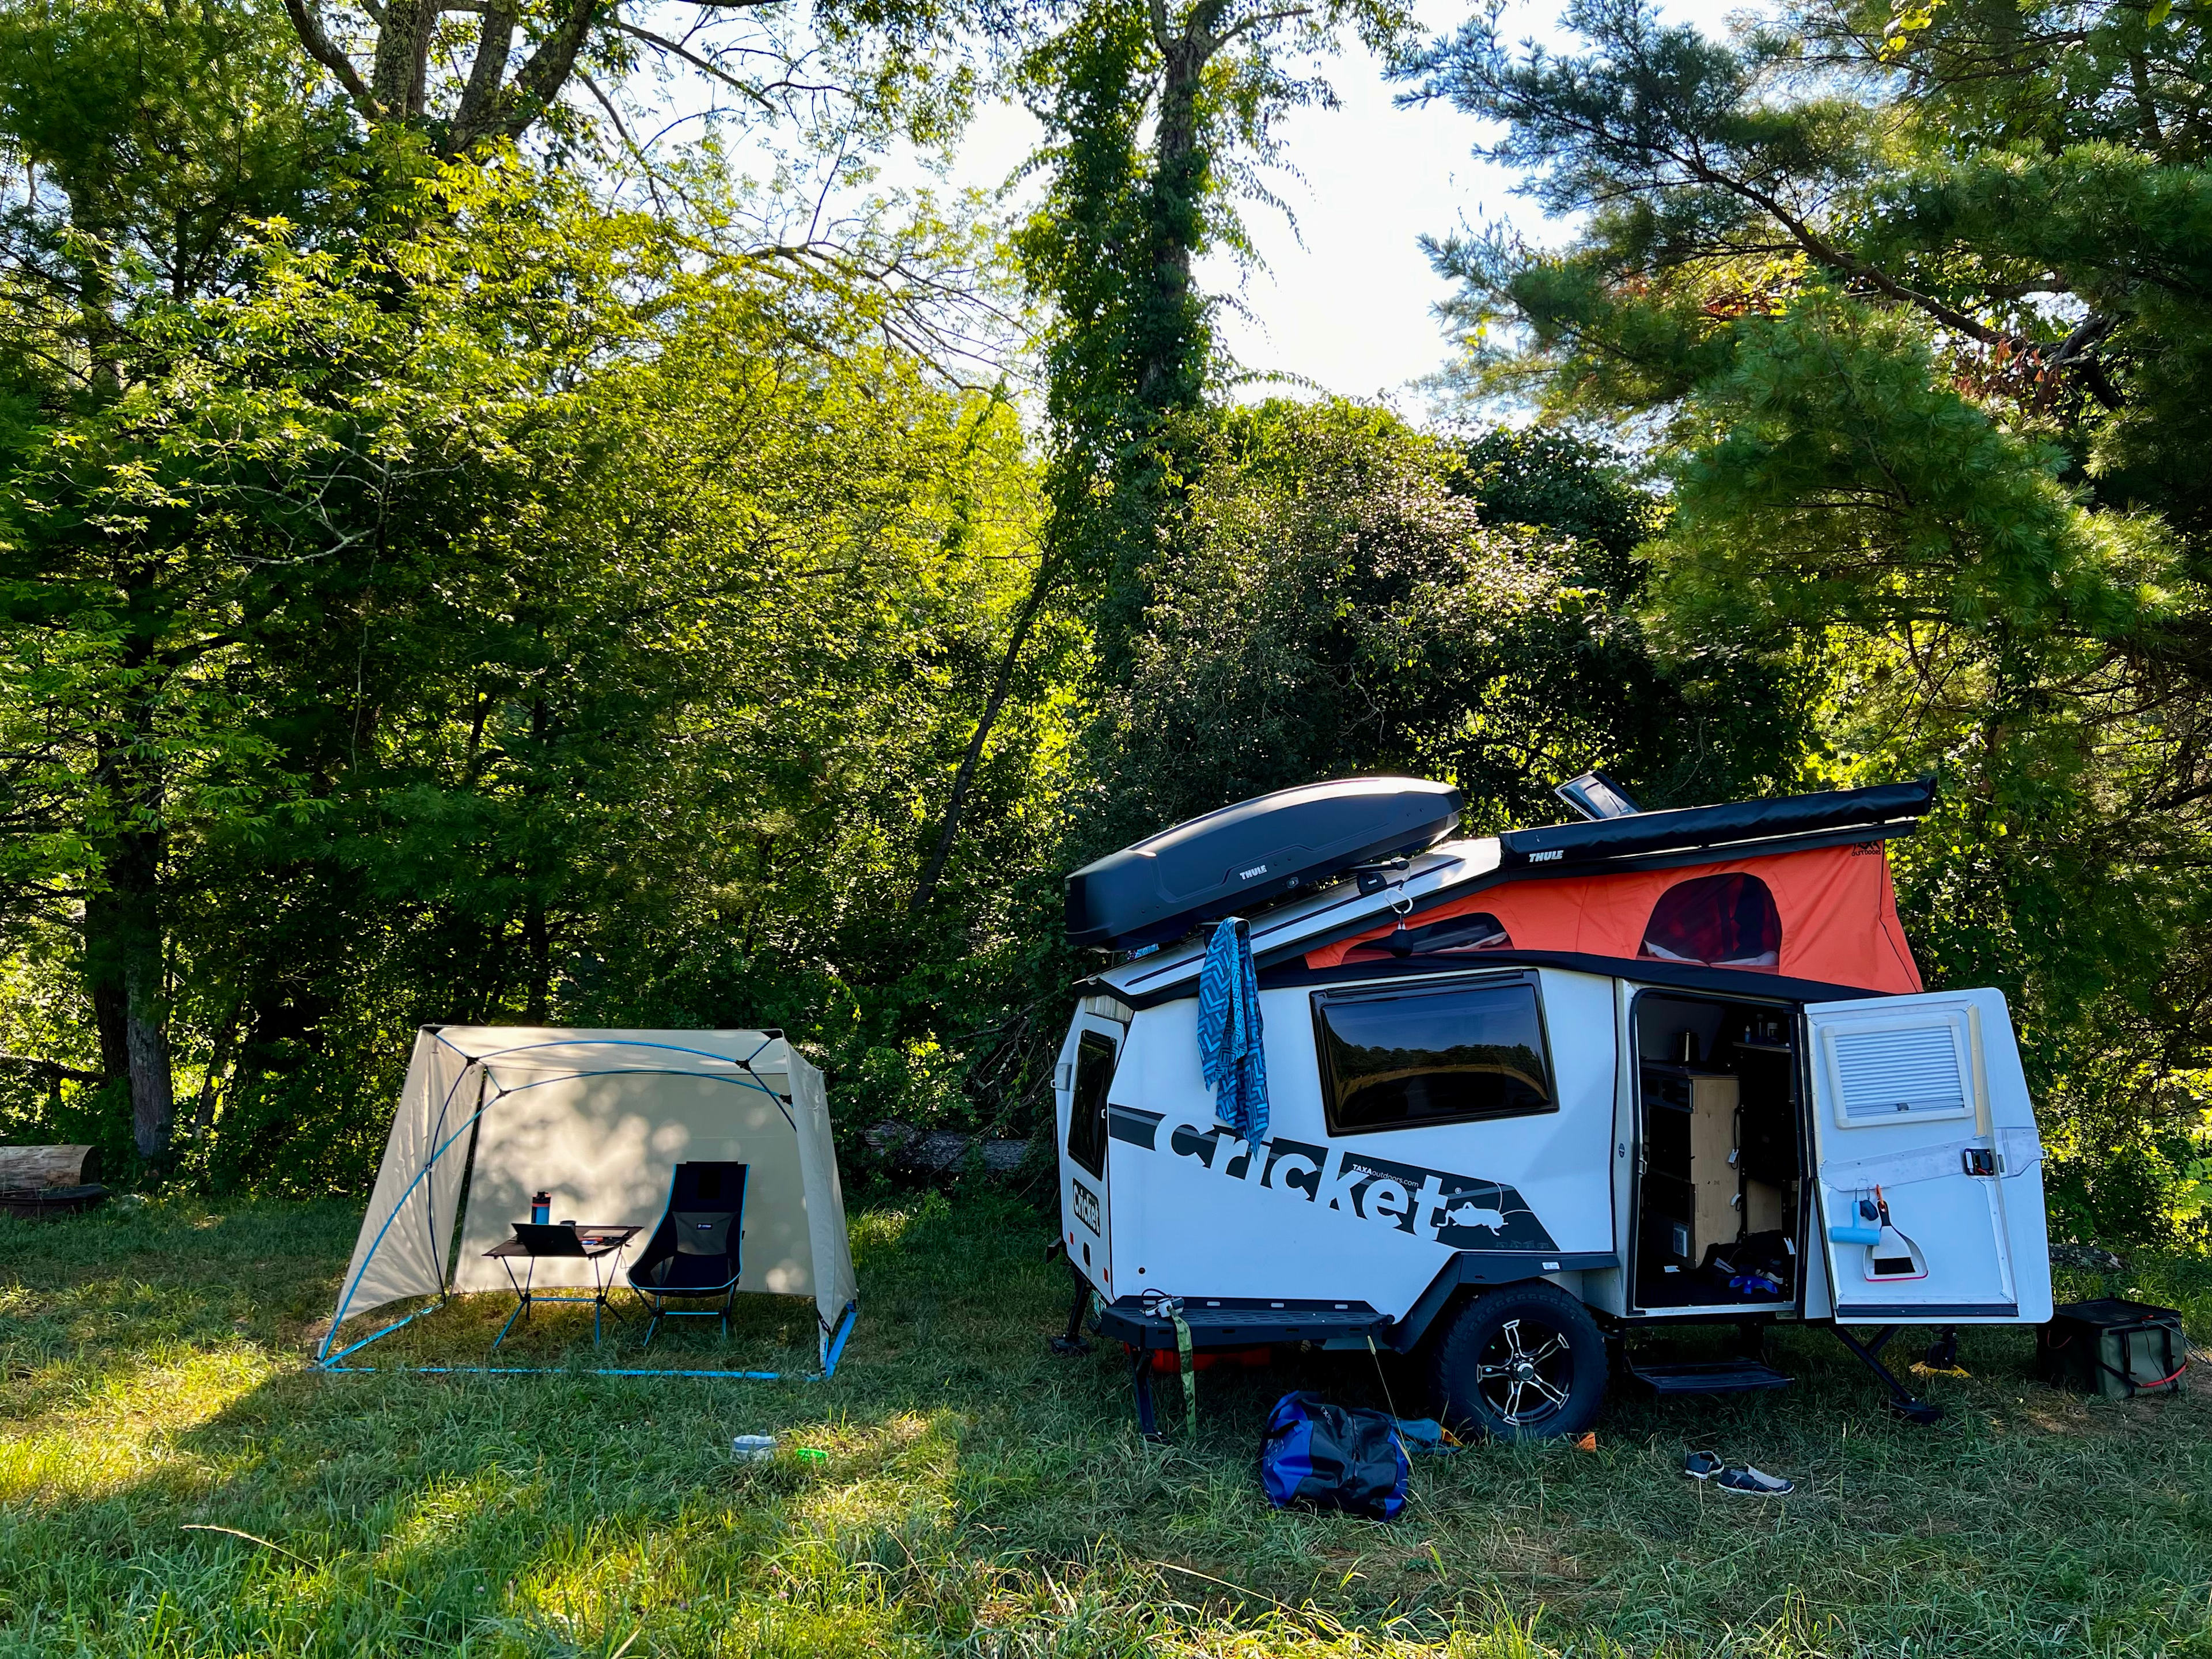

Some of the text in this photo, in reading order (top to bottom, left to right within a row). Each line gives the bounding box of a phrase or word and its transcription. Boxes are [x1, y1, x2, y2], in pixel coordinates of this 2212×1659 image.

[1528, 850, 1565, 863] THULE
[1239, 864, 1267, 880] THULE
[1353, 1164, 1419, 1188] TAXAoutdoors.com
[1073, 1184, 1100, 1233] Cricket
